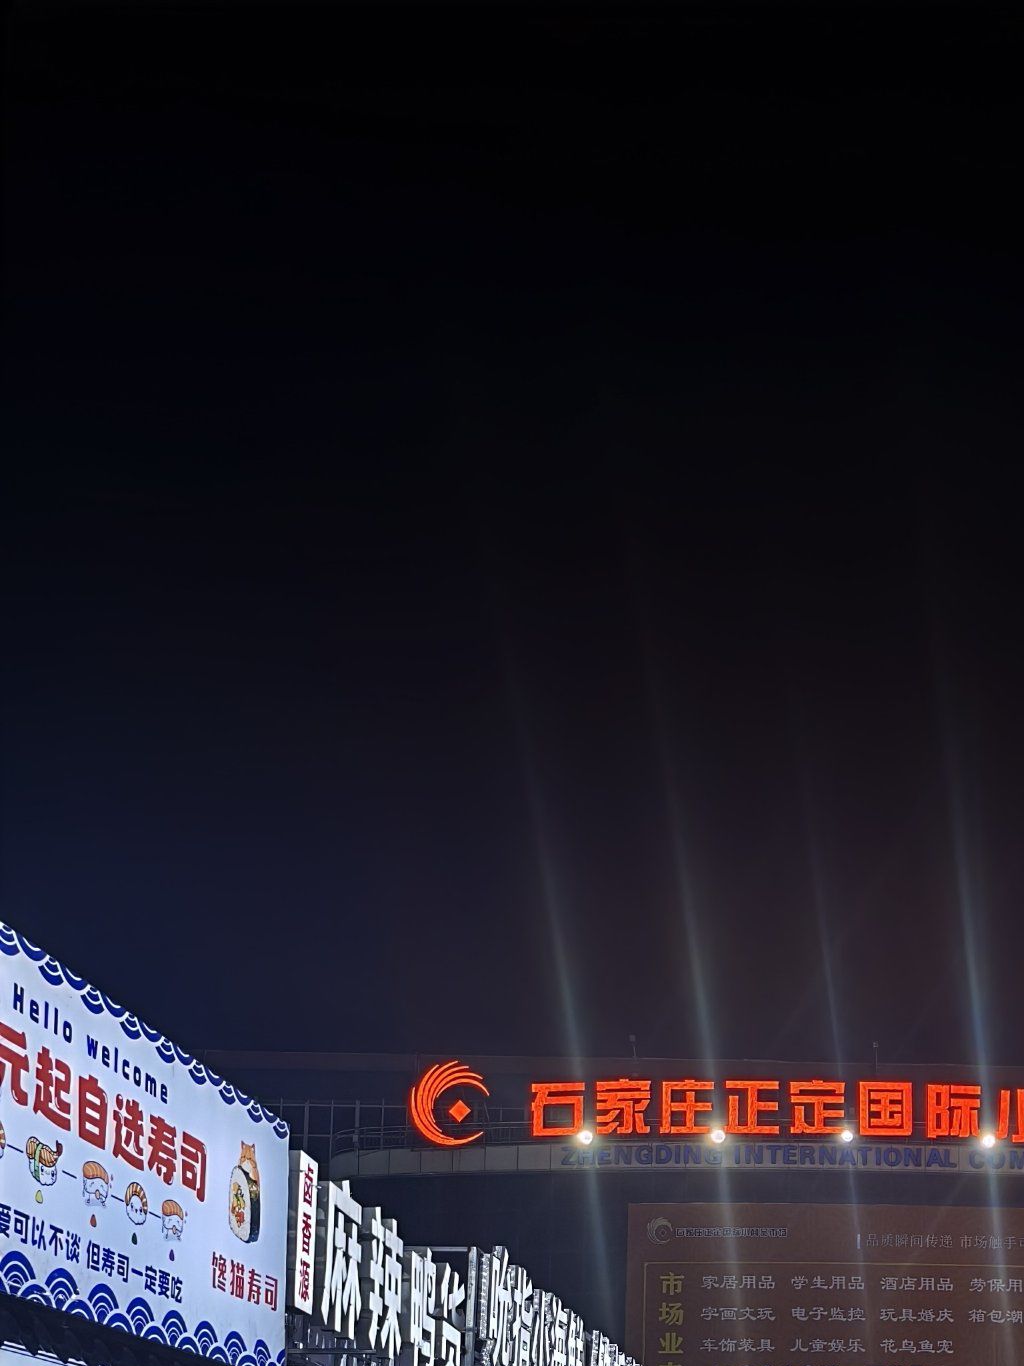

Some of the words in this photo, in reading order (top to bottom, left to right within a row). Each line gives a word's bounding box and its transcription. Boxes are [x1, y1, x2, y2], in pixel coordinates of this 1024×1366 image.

[13, 982, 73, 1043] Hello
[86, 1034, 169, 1104] welcome
[560, 1144, 723, 1167] ZHENGDING
[734, 1145, 957, 1170] INTERNATIONAL
[866, 1233, 953, 1248] 品质瞬间传递
[86, 1239, 184, 1304] 但寿司一定要吃
[212, 1251, 279, 1312] 馋猫寿司
[700, 1275, 776, 1290] 家居用品
[791, 1275, 865, 1291] 学生用品
[880, 1276, 954, 1292] 酒店用品
[700, 1306, 776, 1322] 字画文玩
[791, 1307, 866, 1322] 电子监控
[880, 1308, 954, 1323] 玩具婚庆
[699, 1337, 775, 1353] 车饰装具
[789, 1338, 866, 1353] 儿童娱乐
[880, 1338, 954, 1354] 花鸟鱼宠
